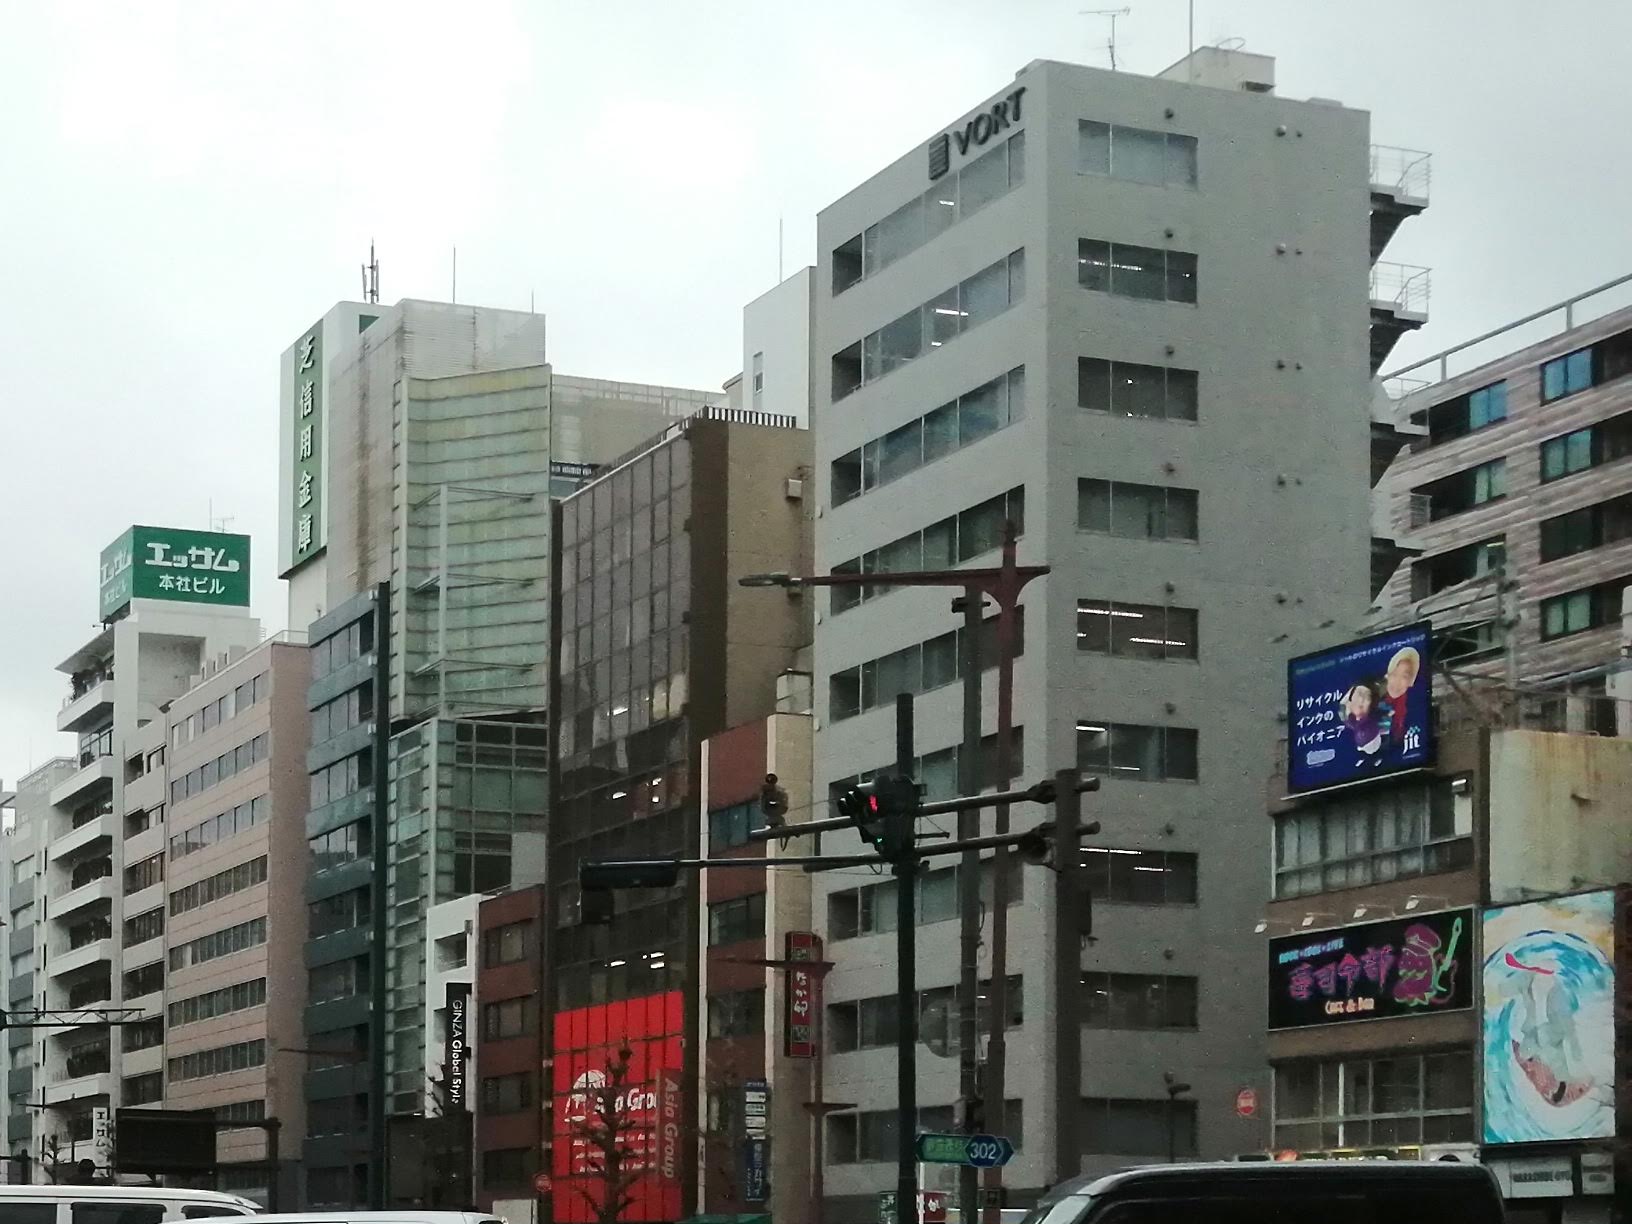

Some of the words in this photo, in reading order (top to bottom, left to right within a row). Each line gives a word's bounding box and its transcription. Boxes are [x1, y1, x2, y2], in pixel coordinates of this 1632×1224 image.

[953, 86, 1027, 155] VORT
[299, 335, 315, 552] 芝信用金庫
[144, 543, 240, 573] エッサム
[159, 573, 226, 595] 本社ビル
[1296, 690, 1343, 711] リサイクル
[1296, 710, 1334, 729] インクの
[1402, 733, 1421, 755] jit
[452, 1000, 463, 1038] GINZA
[452, 1040, 463, 1075] Global
[665, 1078, 678, 1118] Asia
[661, 1122, 678, 1179] Group
[970, 1142, 997, 1159] 302
